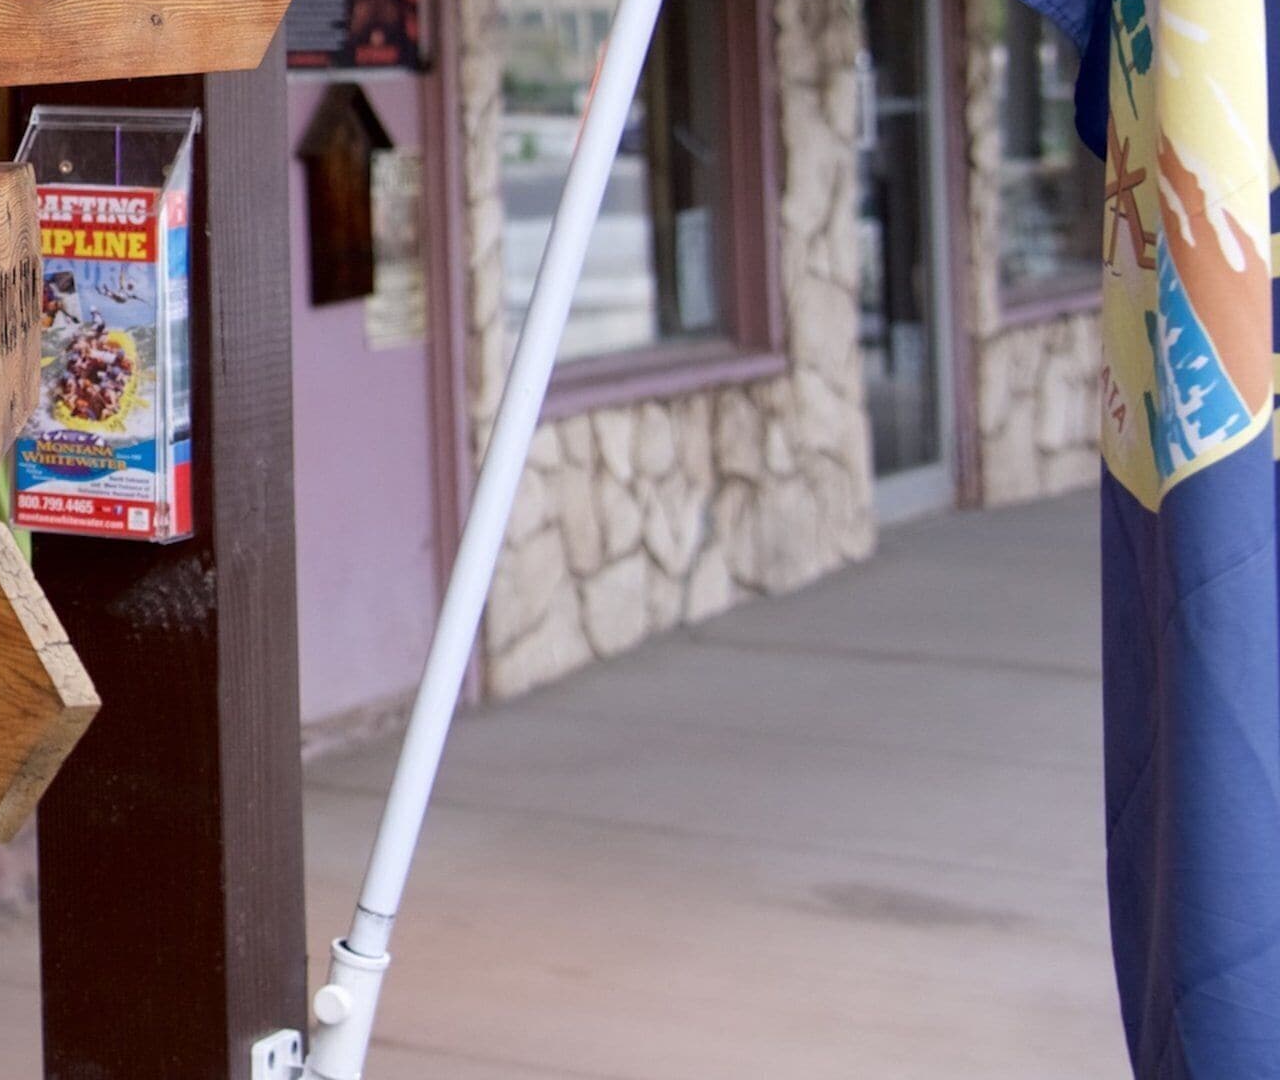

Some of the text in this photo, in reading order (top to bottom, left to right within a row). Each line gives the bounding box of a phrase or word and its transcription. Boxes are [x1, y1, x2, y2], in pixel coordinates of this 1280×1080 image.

[37, 194, 148, 226] AFTING
[41, 227, 148, 260] IPLINE
[36, 440, 113, 457] MONTANA
[21, 450, 128, 472] WHITEWATER
[18, 494, 94, 514] 800.799.4465
